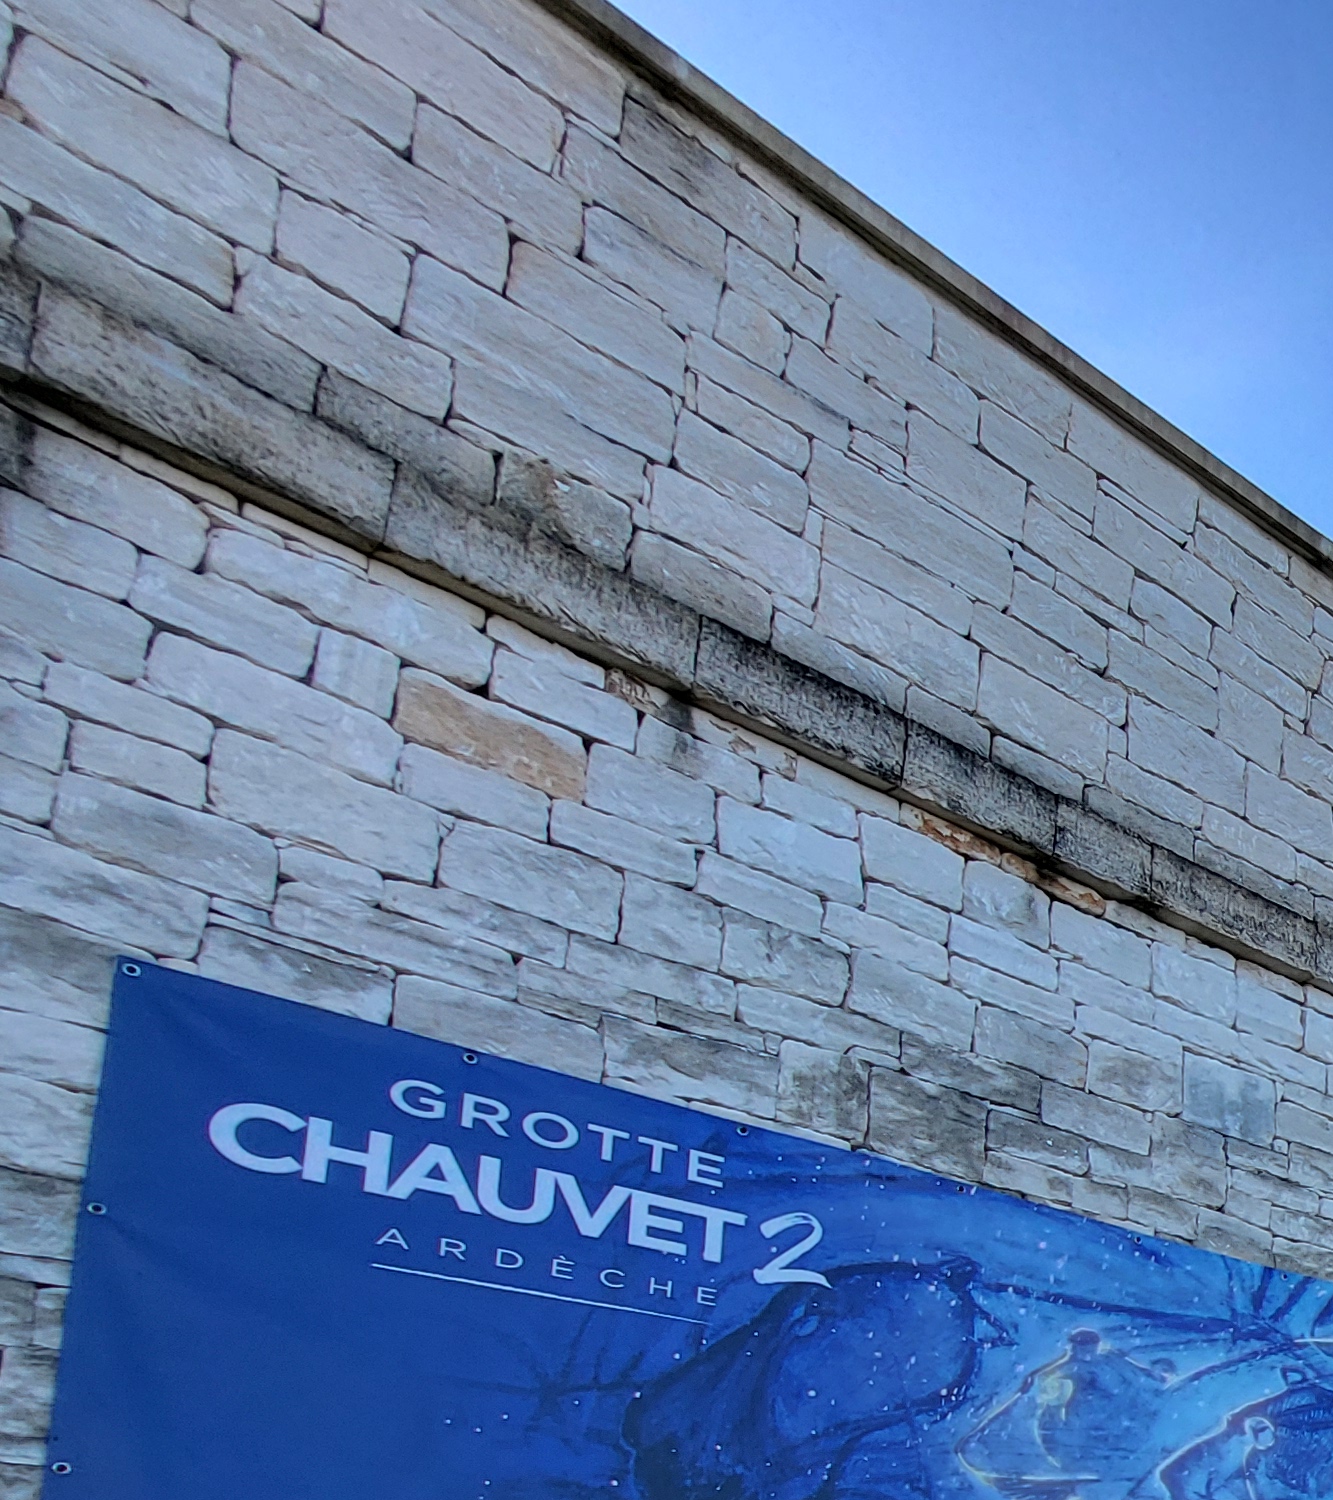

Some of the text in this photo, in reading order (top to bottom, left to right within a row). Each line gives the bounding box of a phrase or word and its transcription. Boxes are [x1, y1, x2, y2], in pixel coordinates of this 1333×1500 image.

[390, 1079, 726, 1188] GROTTE
[208, 1102, 833, 1289] CHAUVET 2
[375, 1228, 718, 1306] ARDÈCHE
